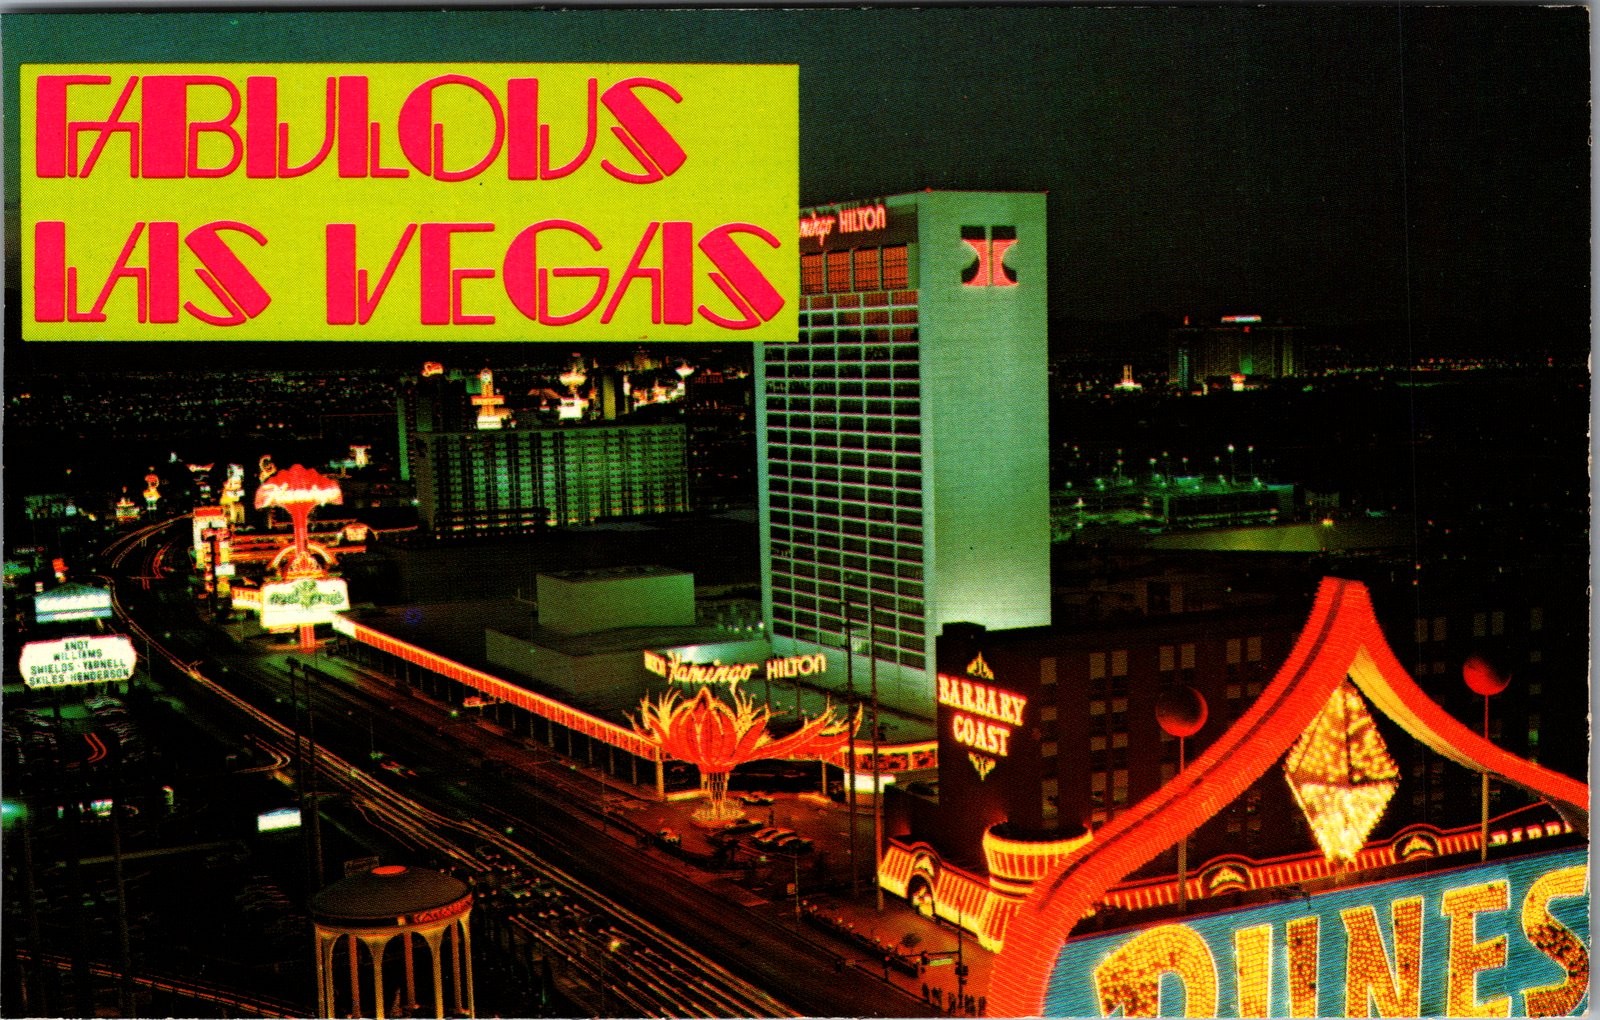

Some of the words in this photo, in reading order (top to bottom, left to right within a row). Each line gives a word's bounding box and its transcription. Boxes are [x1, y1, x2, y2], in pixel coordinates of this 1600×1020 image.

[839, 204, 886, 233] HILTON
[53, 648, 103, 661] WILLIAMS
[64, 640, 89, 652] ANDY
[28, 674, 65, 686] SKILES
[70, 668, 129, 682] HENDERSON
[30, 662, 74, 675] SHIELDS
[82, 658, 126, 670] YARNELL
[668, 650, 759, 694] Flamingo
[766, 652, 827, 681] HILTON
[938, 672, 1028, 727] BARBARY
[953, 712, 1011, 757] COAST
[1093, 864, 1590, 1018] DUNES
